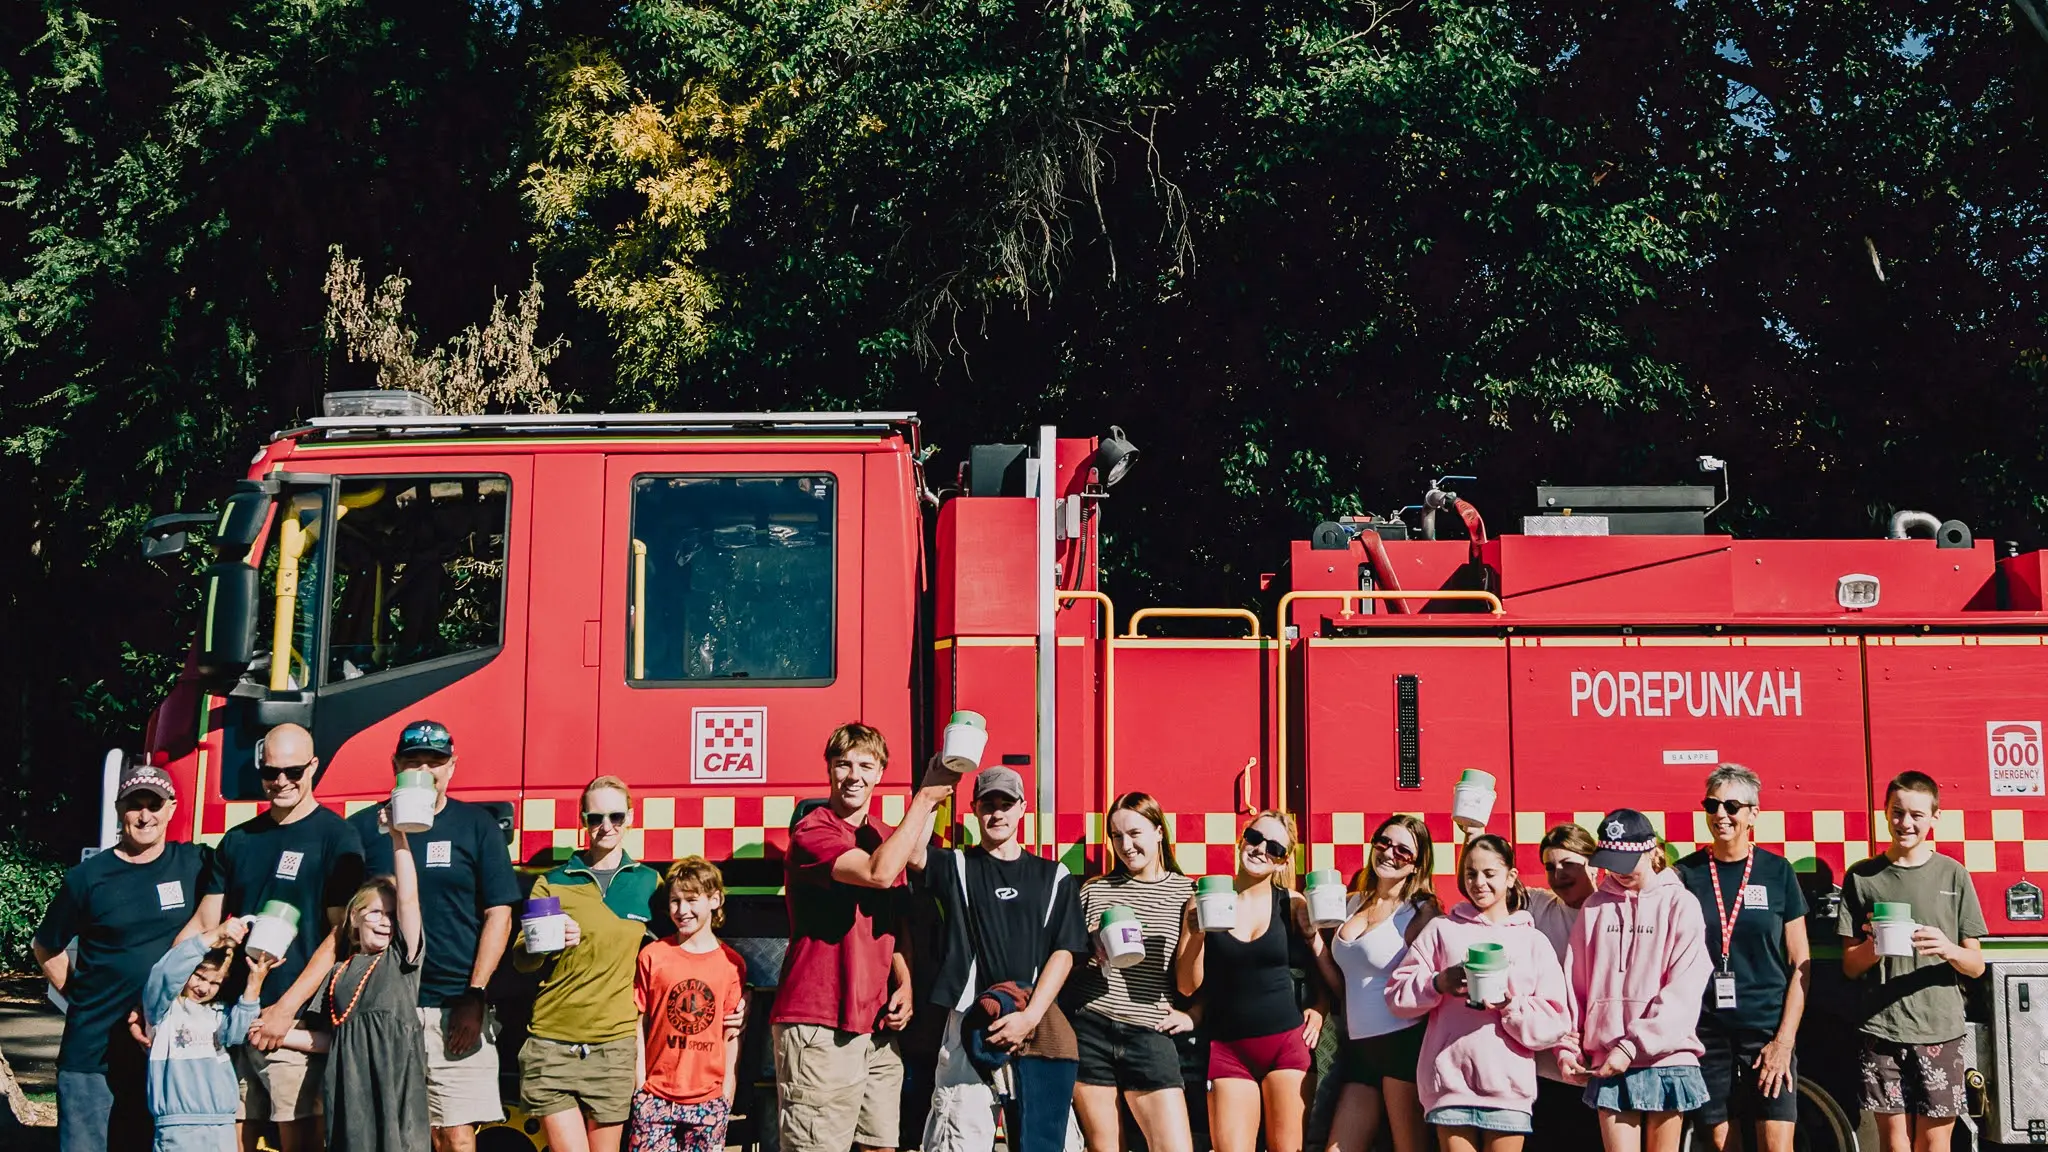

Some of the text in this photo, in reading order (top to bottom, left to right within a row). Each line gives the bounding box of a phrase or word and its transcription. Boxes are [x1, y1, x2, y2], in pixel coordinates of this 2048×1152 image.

[1570, 670, 1802, 717] POREPUNKAH
[703, 753, 754, 772] CFA
[1993, 743, 2039, 766] 000
[1994, 769, 2040, 780] EMERGENCY
[673, 980, 706, 994] TRAIL
[688, 1040, 715, 1052] SPORT
